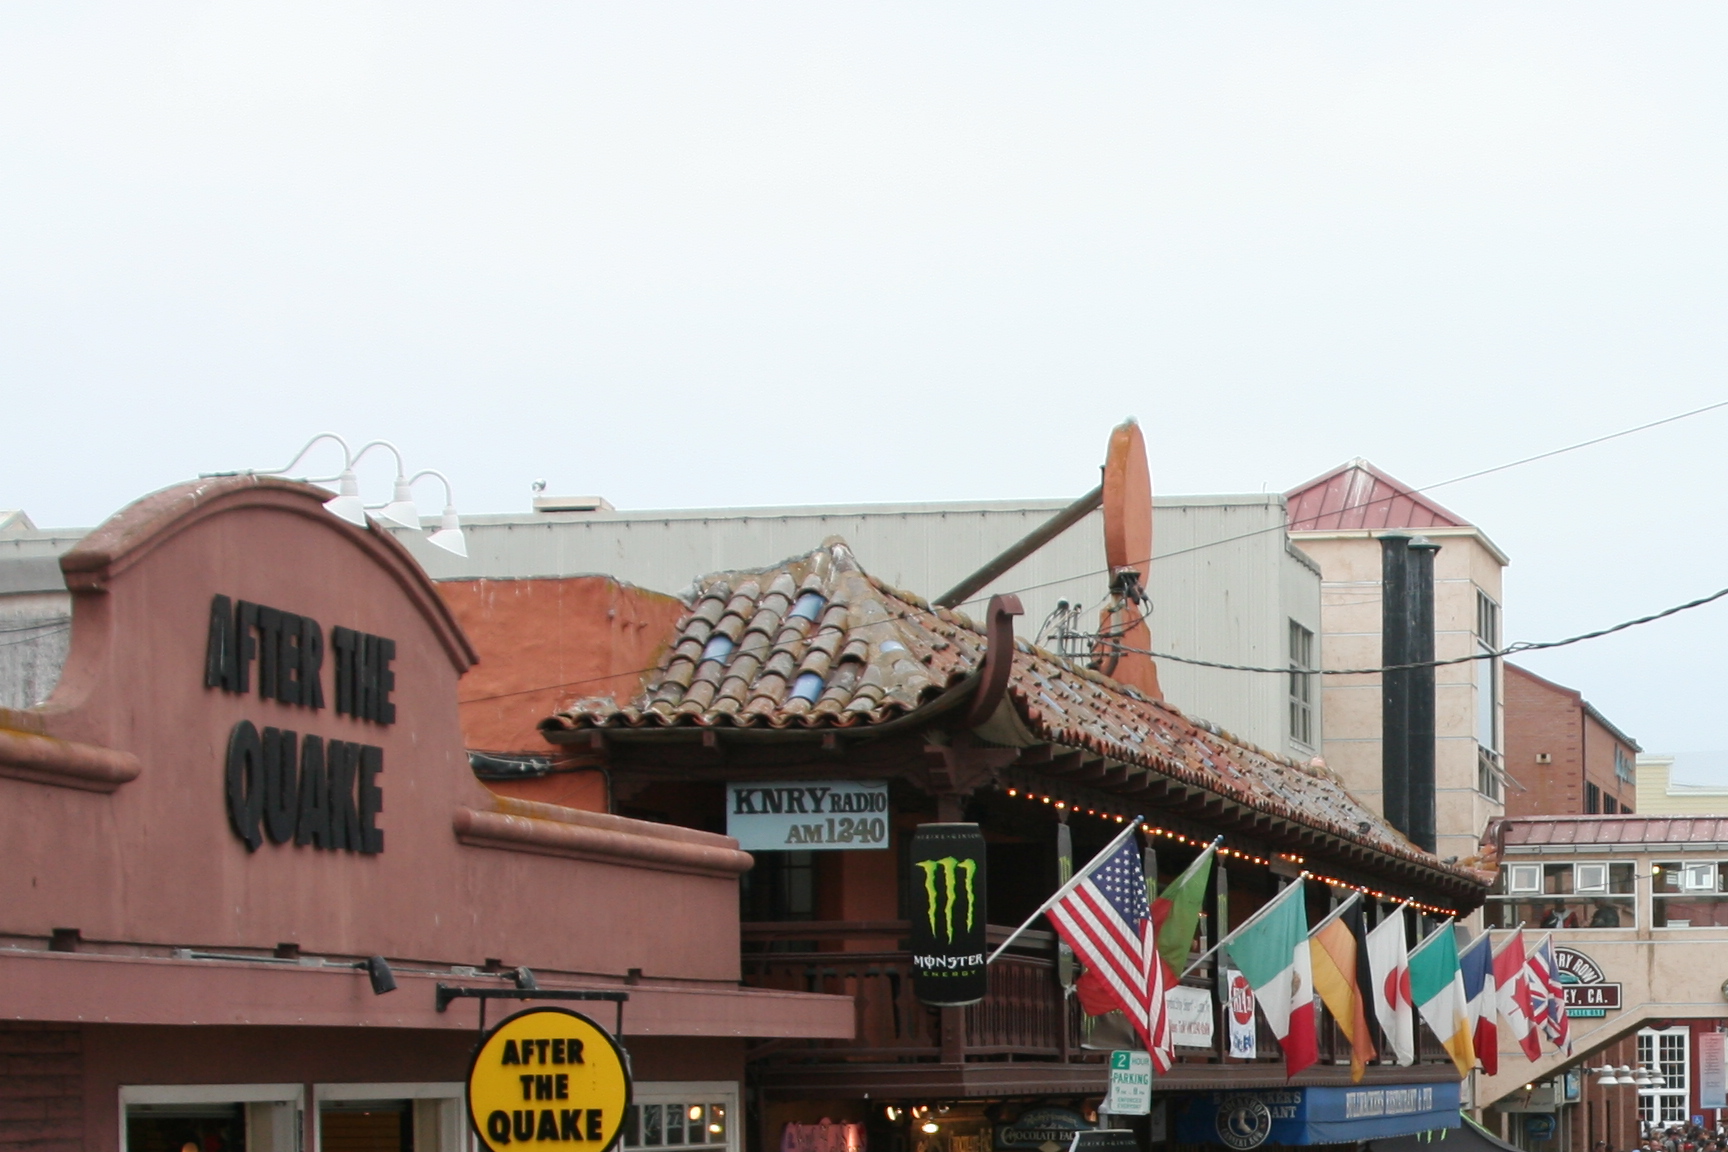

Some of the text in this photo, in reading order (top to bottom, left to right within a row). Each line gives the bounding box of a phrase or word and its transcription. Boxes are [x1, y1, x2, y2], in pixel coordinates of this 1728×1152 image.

[206, 593, 396, 725] AFTER THE
[226, 719, 385, 853] QUAKE
[733, 787, 886, 814] KNRY RADIO
[784, 817, 885, 844] AM 1240
[914, 953, 984, 970] MONSTER
[1572, 958, 1598, 983] ROW
[1587, 988, 1609, 1004] CA.
[501, 1038, 585, 1066] AFTER
[1117, 1053, 1126, 1067] 2
[519, 1074, 569, 1101] THE
[1113, 1072, 1149, 1086] PARKING
[487, 1108, 603, 1145] QUAKE
